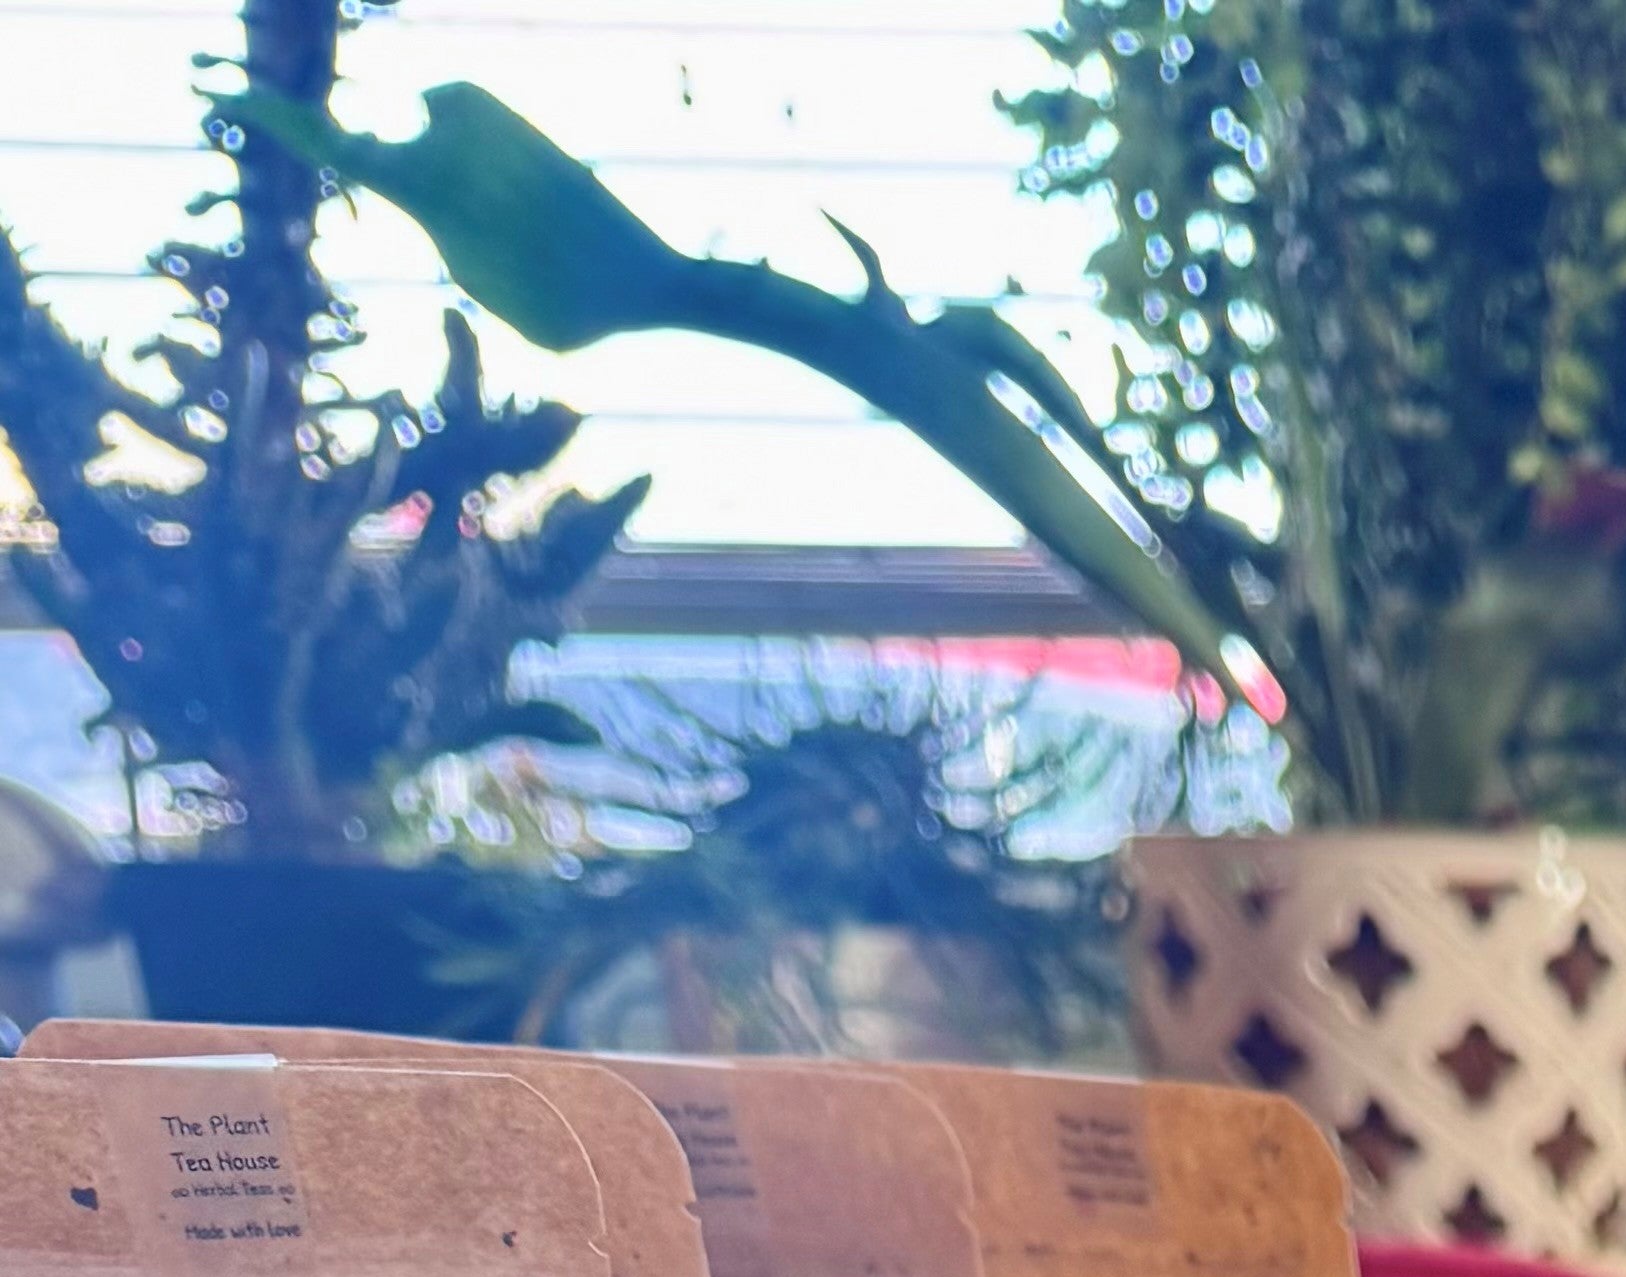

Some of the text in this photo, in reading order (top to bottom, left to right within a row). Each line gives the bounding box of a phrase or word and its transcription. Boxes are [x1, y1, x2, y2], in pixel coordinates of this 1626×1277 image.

[161, 1113, 270, 1137] The Plant
[170, 1150, 280, 1172] Tea House
[230, 1221, 264, 1239] with
